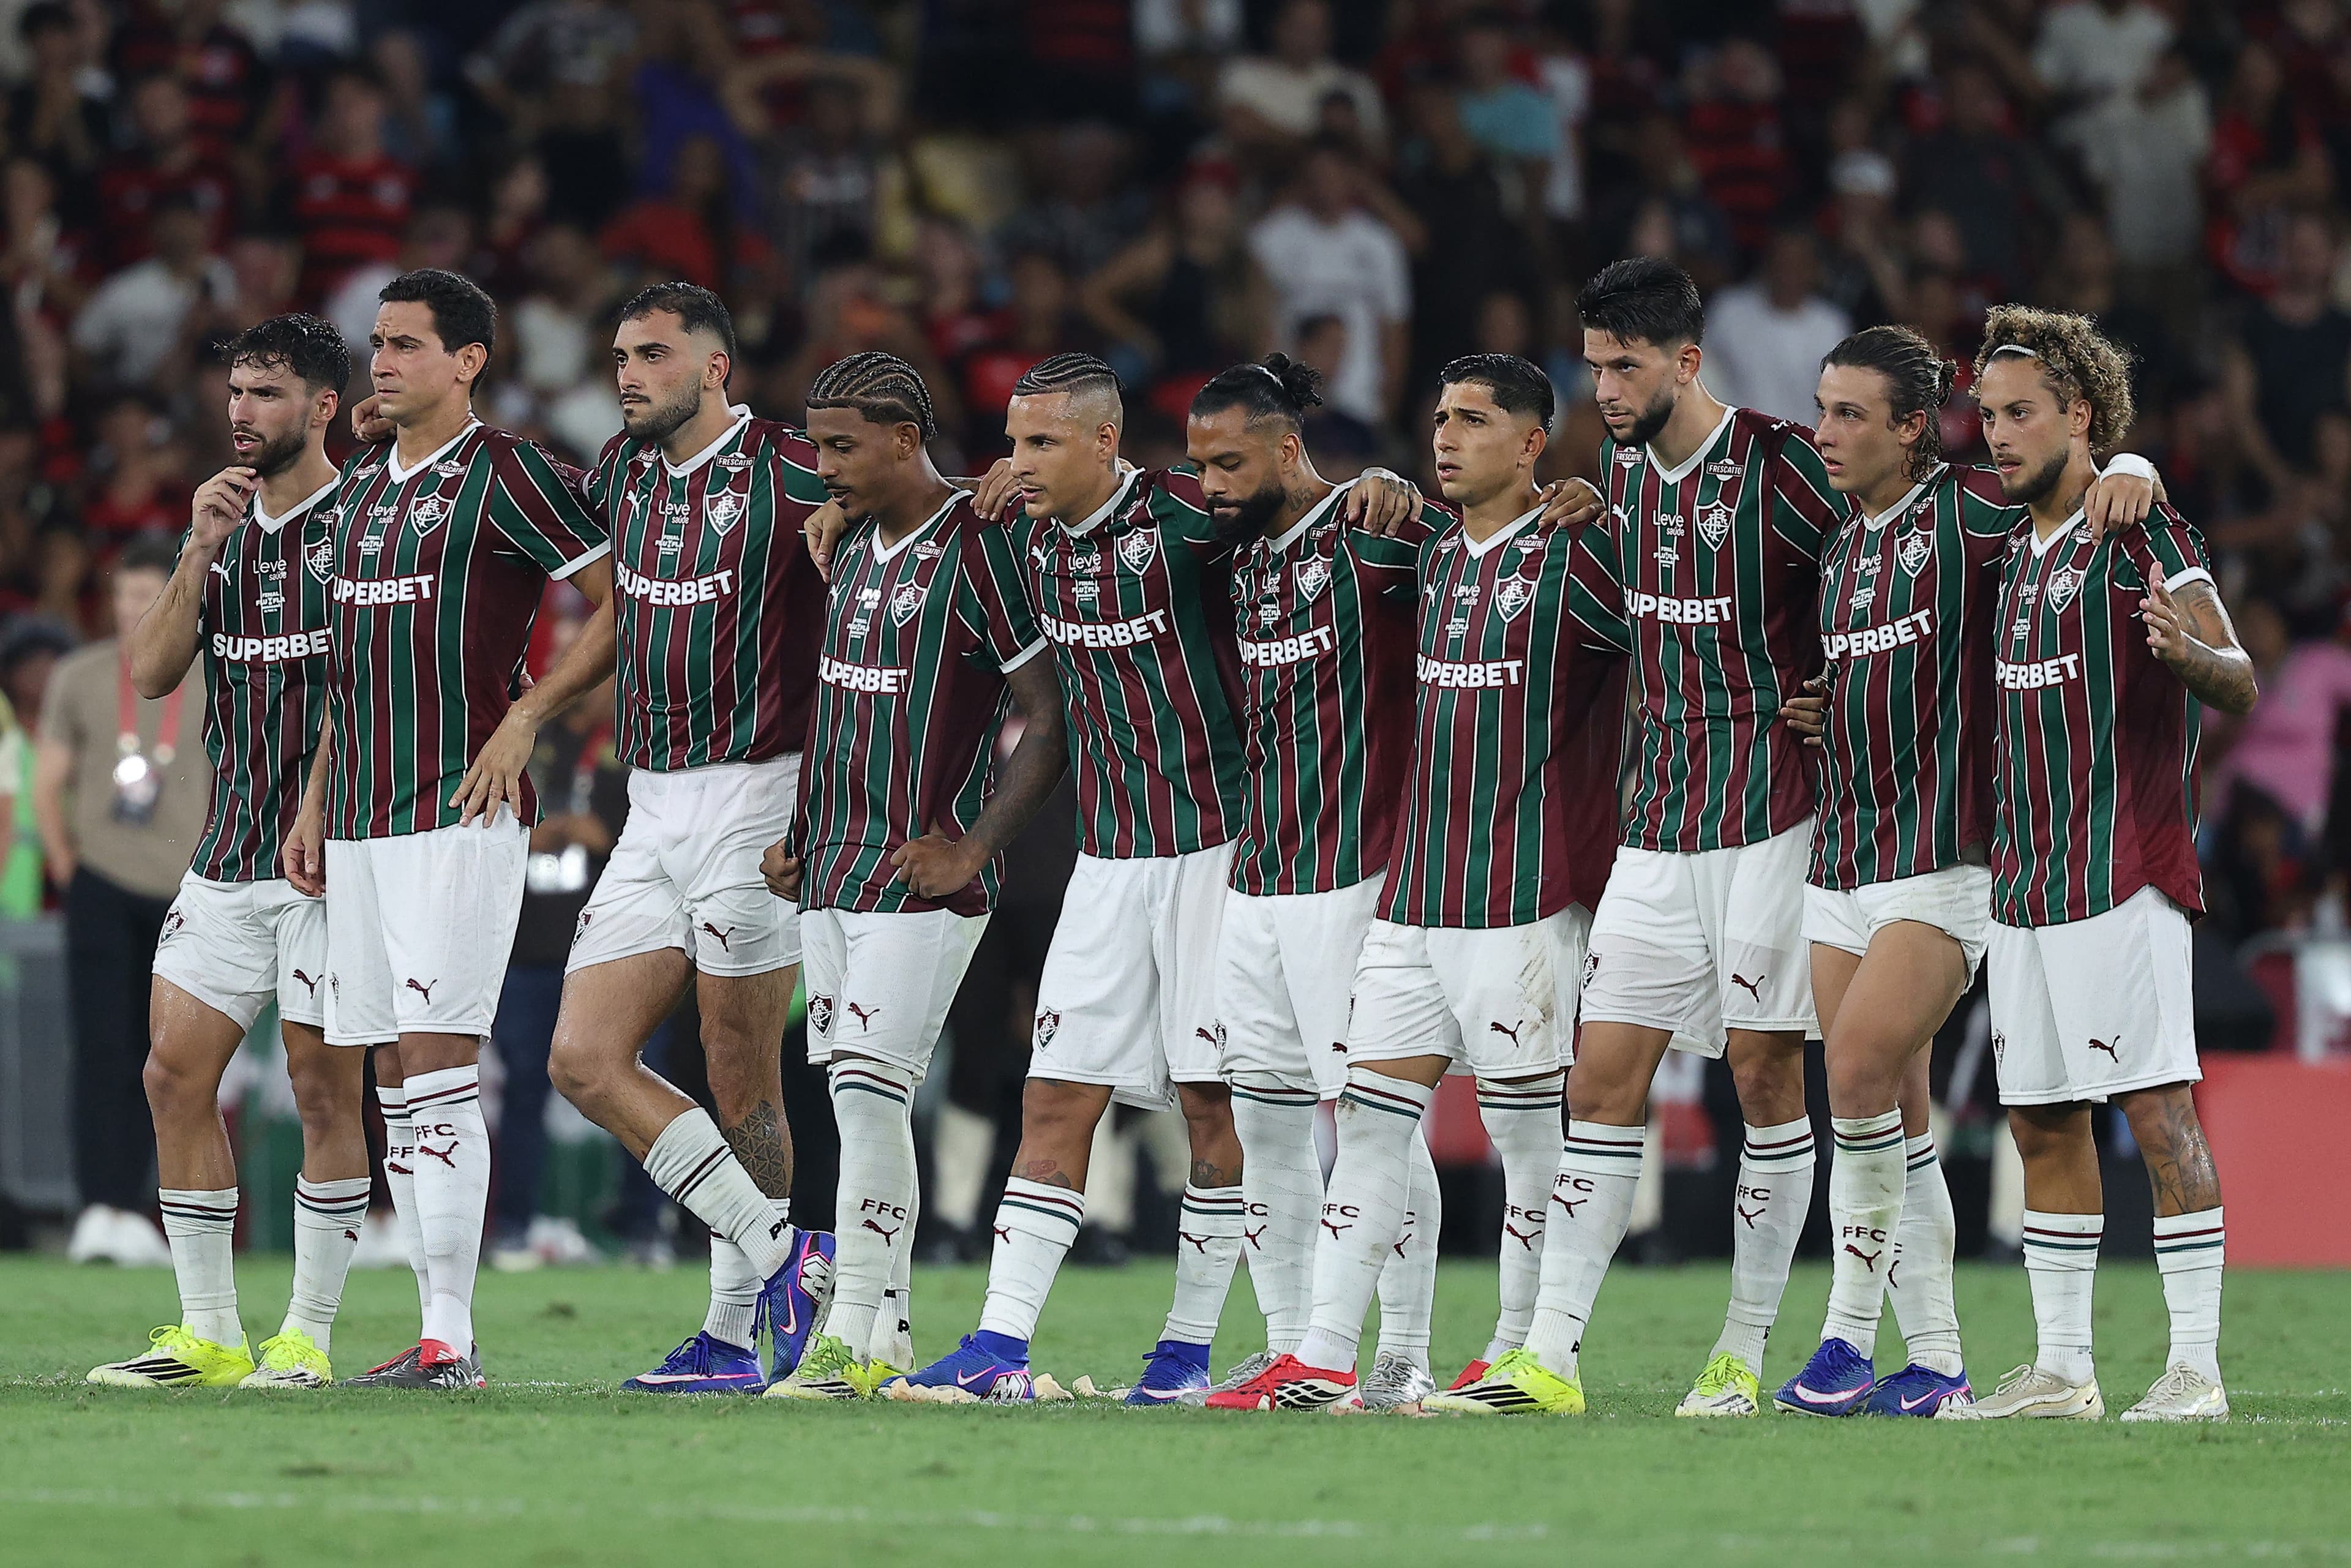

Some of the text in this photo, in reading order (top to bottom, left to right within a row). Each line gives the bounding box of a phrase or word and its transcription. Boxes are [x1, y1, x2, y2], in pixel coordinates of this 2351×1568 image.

[718, 457, 752, 466] FRESCATTO
[1616, 452, 1642, 462] FRESCATTO
[1709, 465, 1742, 475] FRESCATTO
[367, 503, 399, 516] Leve
[659, 499, 691, 515] Leve
[1653, 509, 1684, 527] Leve
[1666, 526, 1685, 536] saúde
[253, 560, 287, 574] Leve
[1068, 553, 1102, 571] Leve
[1852, 553, 1883, 573] Leve
[333, 574, 434, 606] UPERBET
[617, 561, 733, 606] SUPERBET
[1452, 582, 1481, 598] Leve
[2018, 582, 2039, 598] Leve
[1627, 588, 1733, 623] UPERBET
[1040, 609, 1167, 648] SUPERBET
[1824, 608, 1932, 660] UPERBET
[213, 628, 332, 662] SUPERBE
[1237, 625, 1332, 666] UPERBET
[821, 656, 908, 693] UPERBET
[1997, 653, 2079, 690] PERBET
[414, 1123, 457, 1141] FFC
[390, 1146, 413, 1158] FF
[1553, 1174, 1594, 1192] FFC
[1738, 1184, 1771, 1201] FFC
[860, 1198, 906, 1220] FFC
[1243, 1202, 1268, 1217] FC
[1322, 1203, 1360, 1218] FFC
[1843, 1226, 1886, 1243] FFC
